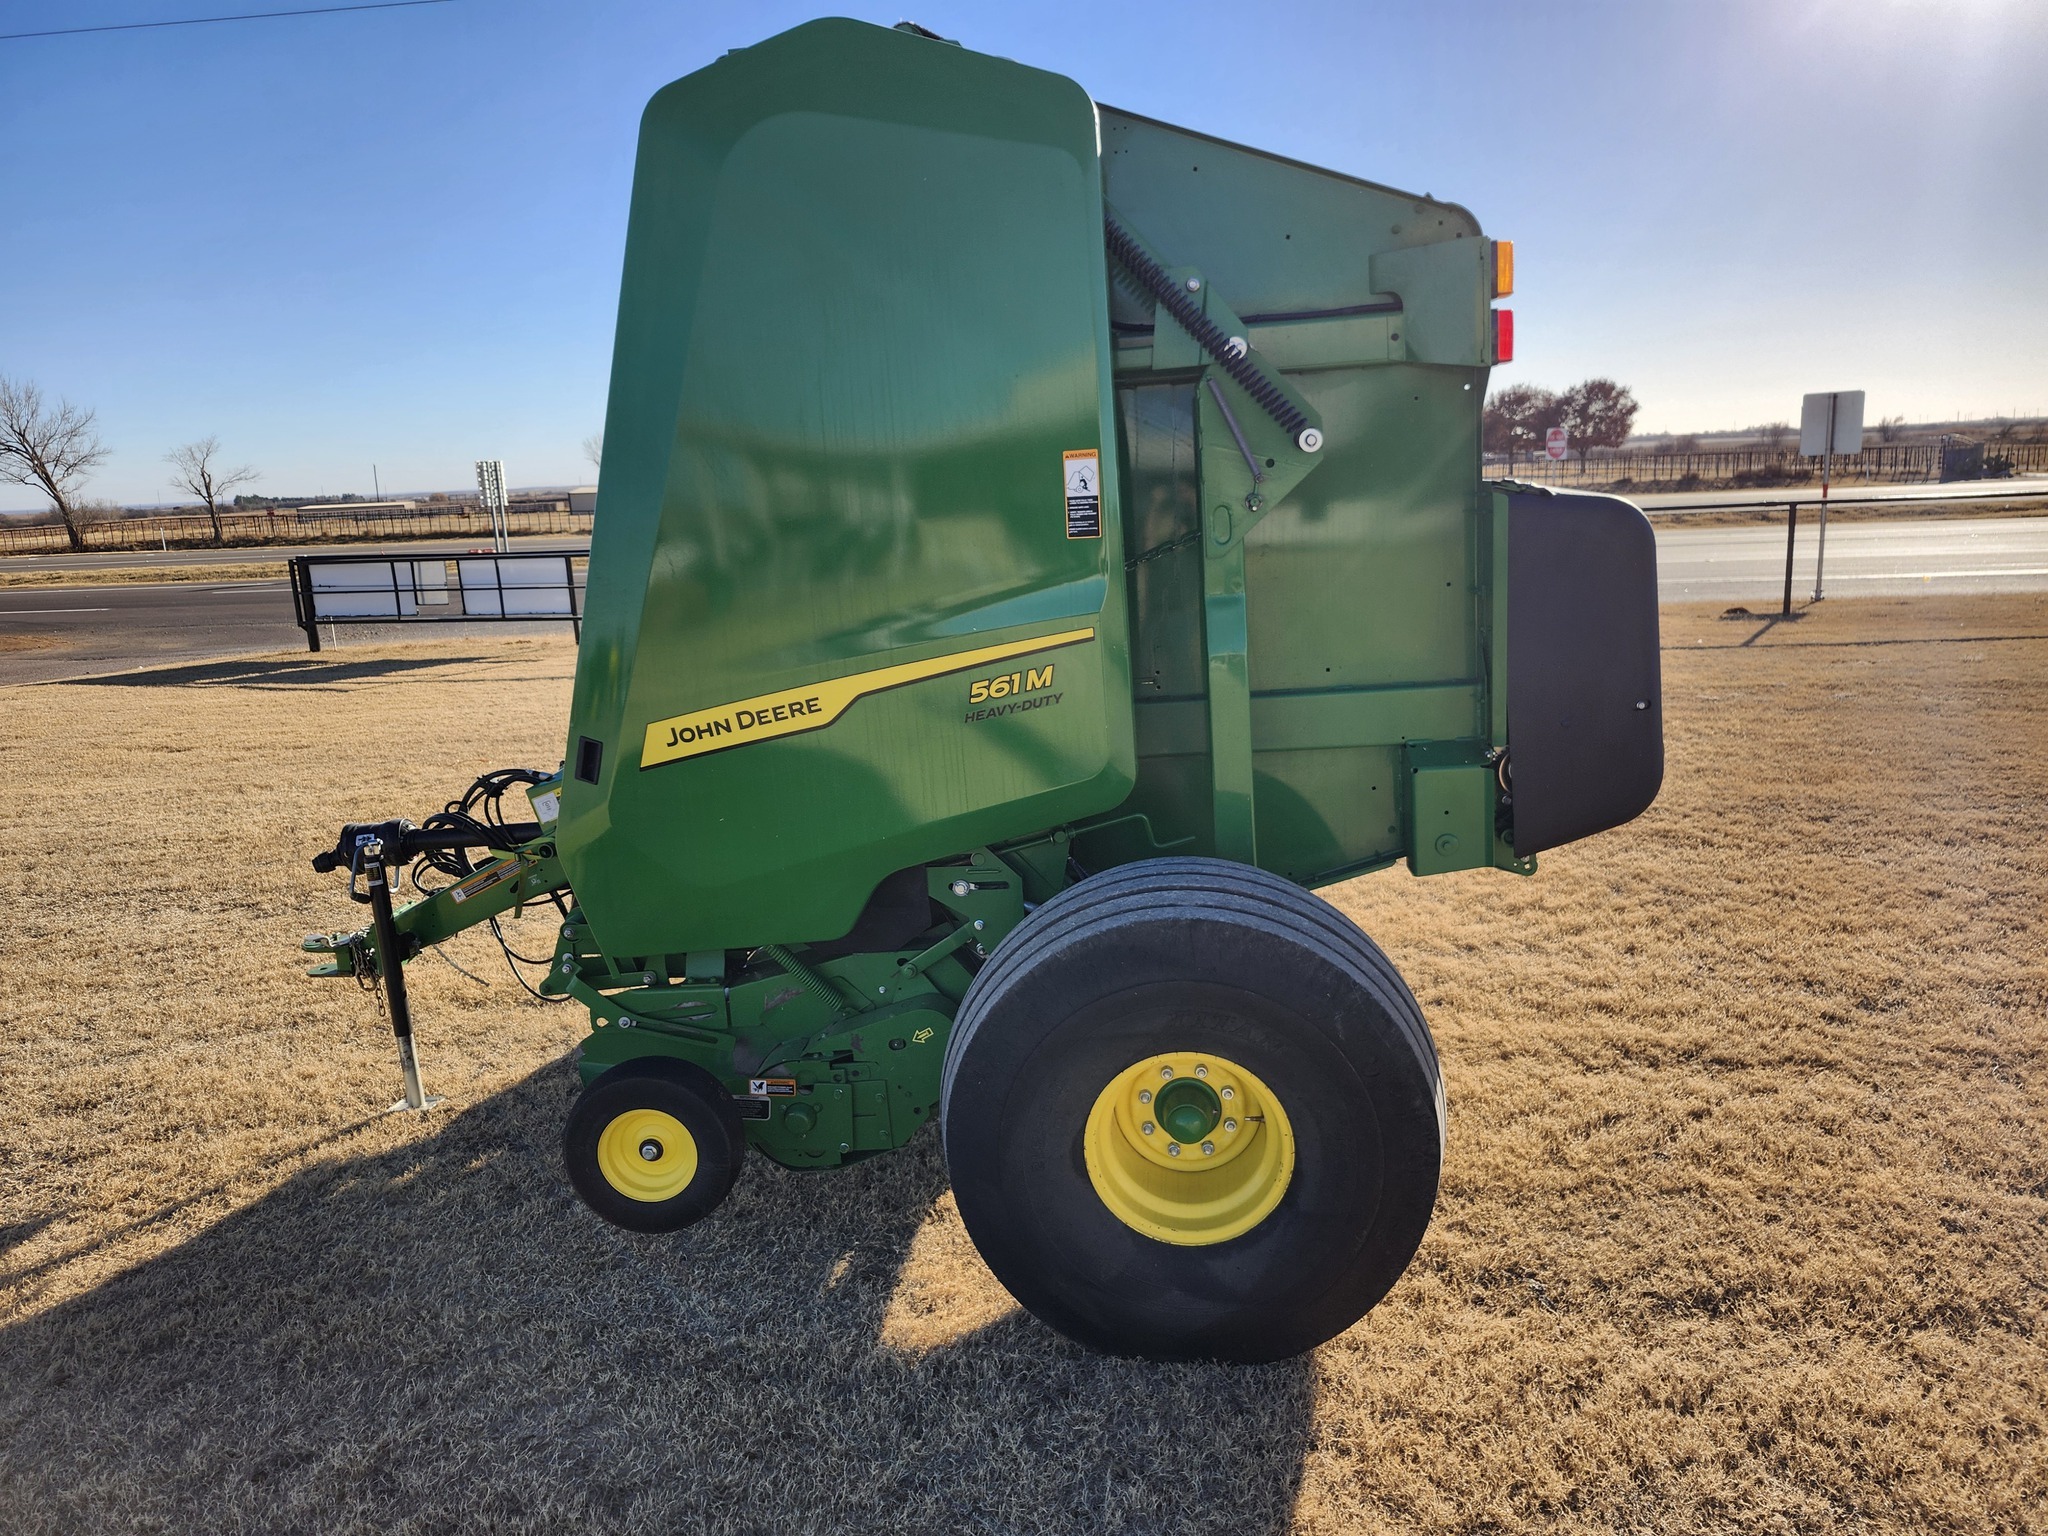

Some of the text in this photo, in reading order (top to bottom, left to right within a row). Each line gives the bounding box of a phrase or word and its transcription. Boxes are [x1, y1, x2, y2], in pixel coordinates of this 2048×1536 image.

[969, 664, 1055, 704] 561 M
[666, 697, 822, 747] JOHN DEERE
[964, 692, 1063, 723] HEAVY-DUTY
